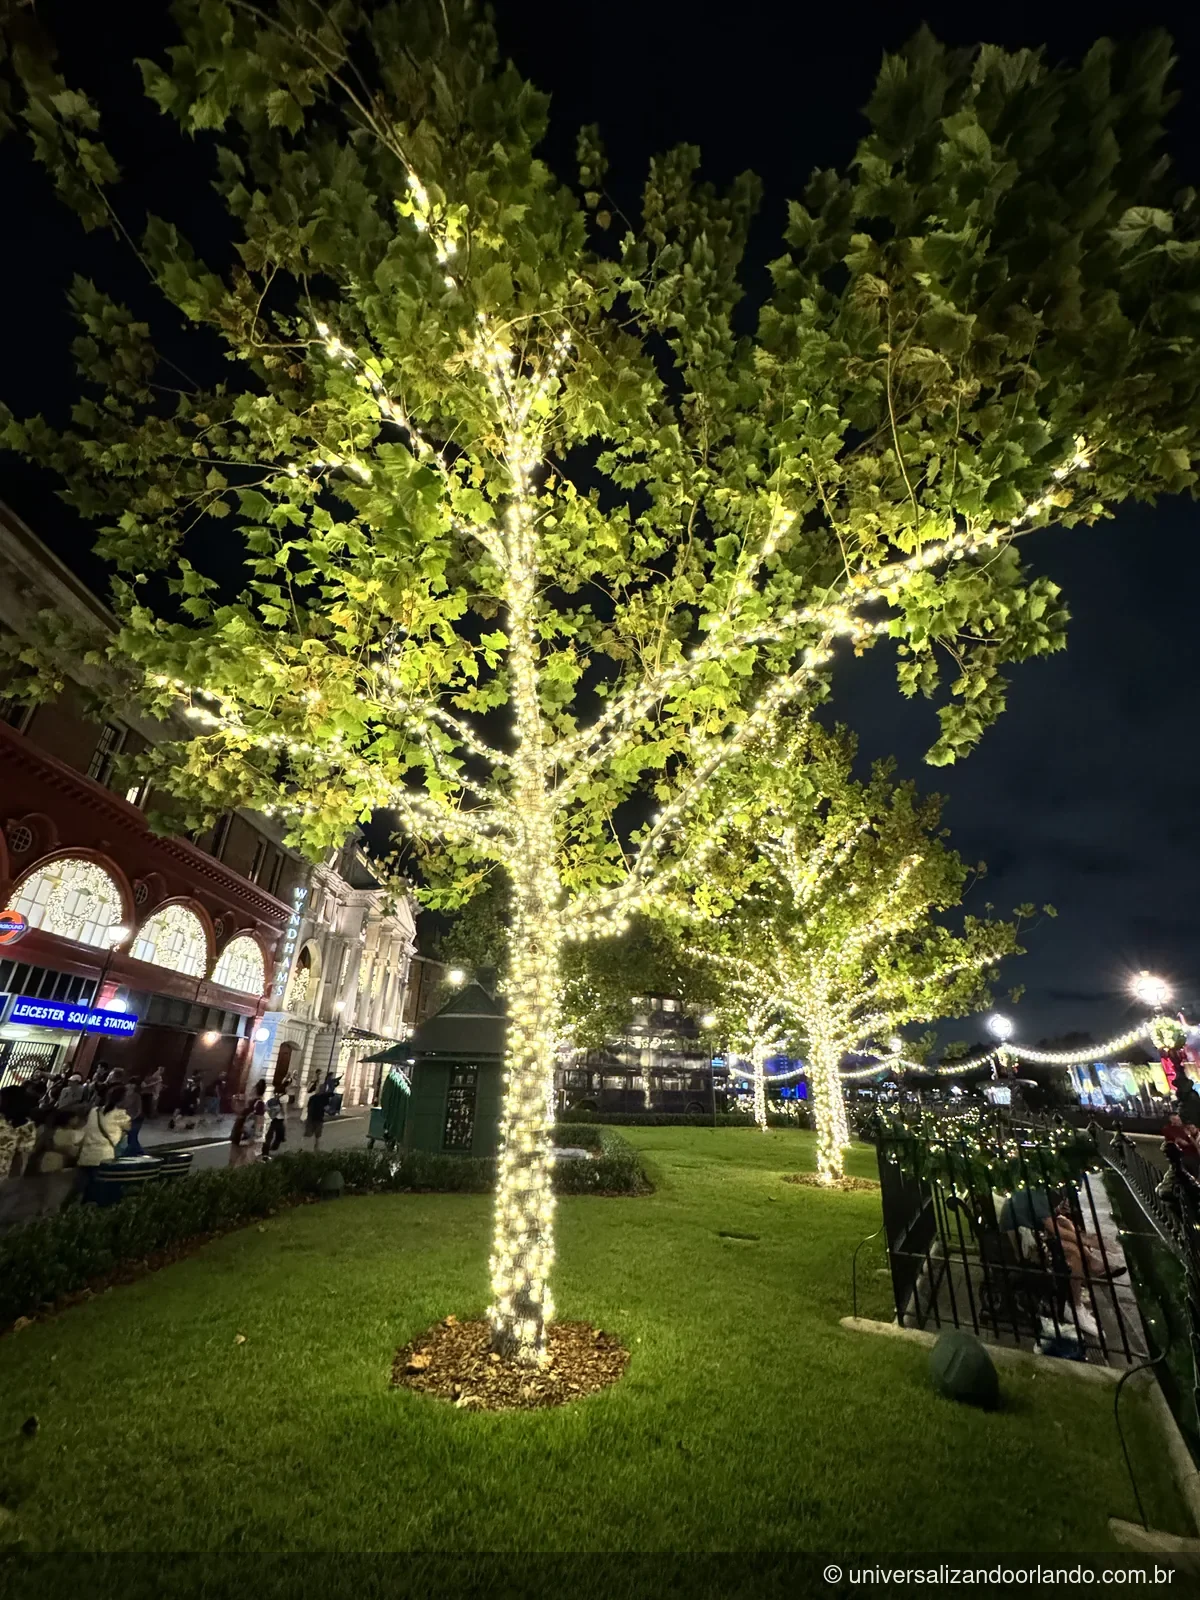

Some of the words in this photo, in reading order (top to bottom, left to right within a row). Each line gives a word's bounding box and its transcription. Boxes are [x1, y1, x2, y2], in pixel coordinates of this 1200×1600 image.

[276, 887, 307, 996] WYNDHAMS
[13, 1004, 65, 1021] LEICESTER
[104, 1017, 136, 1031] STATION
